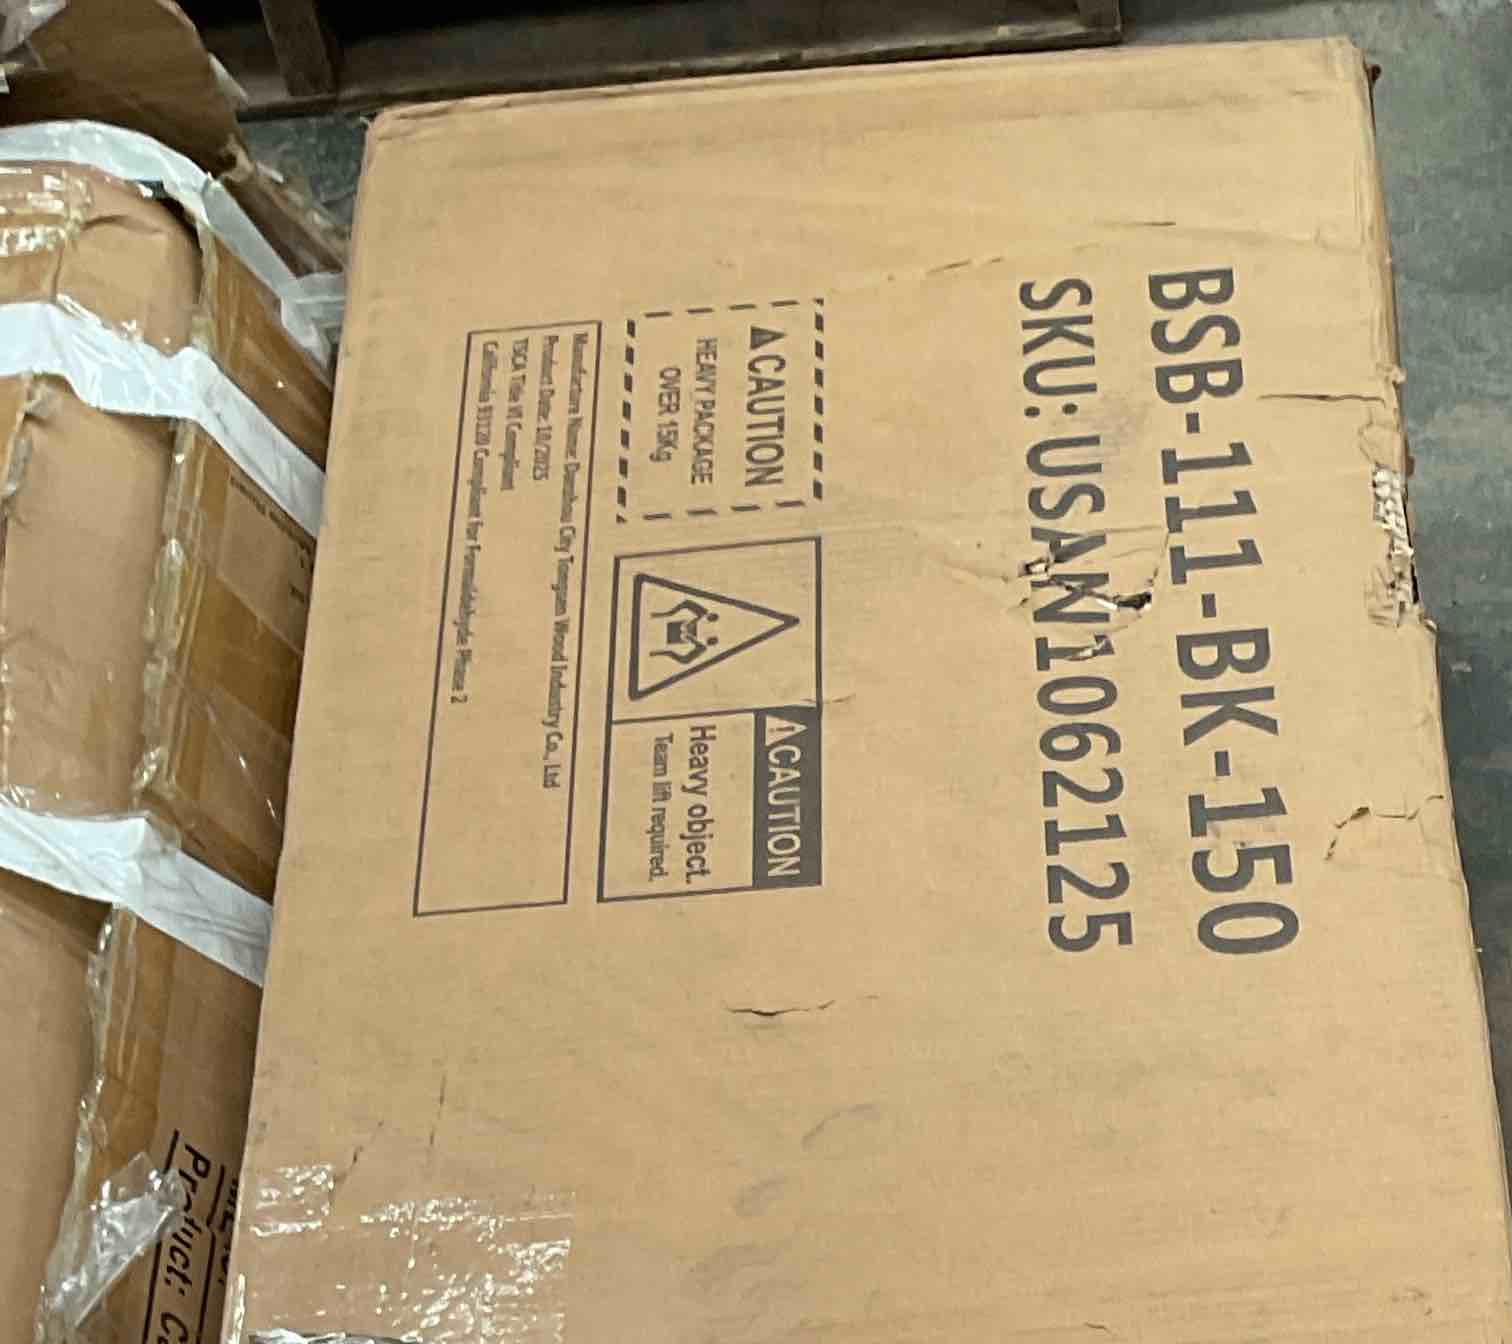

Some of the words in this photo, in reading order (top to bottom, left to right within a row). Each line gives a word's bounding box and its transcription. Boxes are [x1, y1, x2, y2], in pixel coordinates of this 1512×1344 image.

[658, 367, 682, 416] OVER
[695, 338, 718, 395] HEAVY
[649, 419, 680, 463] 15Kg
[690, 399, 716, 486] PACKAGE
[744, 354, 787, 488] CAUTION
[554, 526, 576, 553] City
[1147, 267, 1300, 955] BSB-111-BK-150
[542, 665, 568, 728] Industry
[543, 764, 562, 788] Ltd
[653, 732, 674, 777] Team
[681, 724, 717, 798] Heavy
[651, 781, 673, 804] lift
[767, 744, 802, 877] CAUTION
[644, 807, 670, 882] required.
[679, 803, 715, 885] object.
